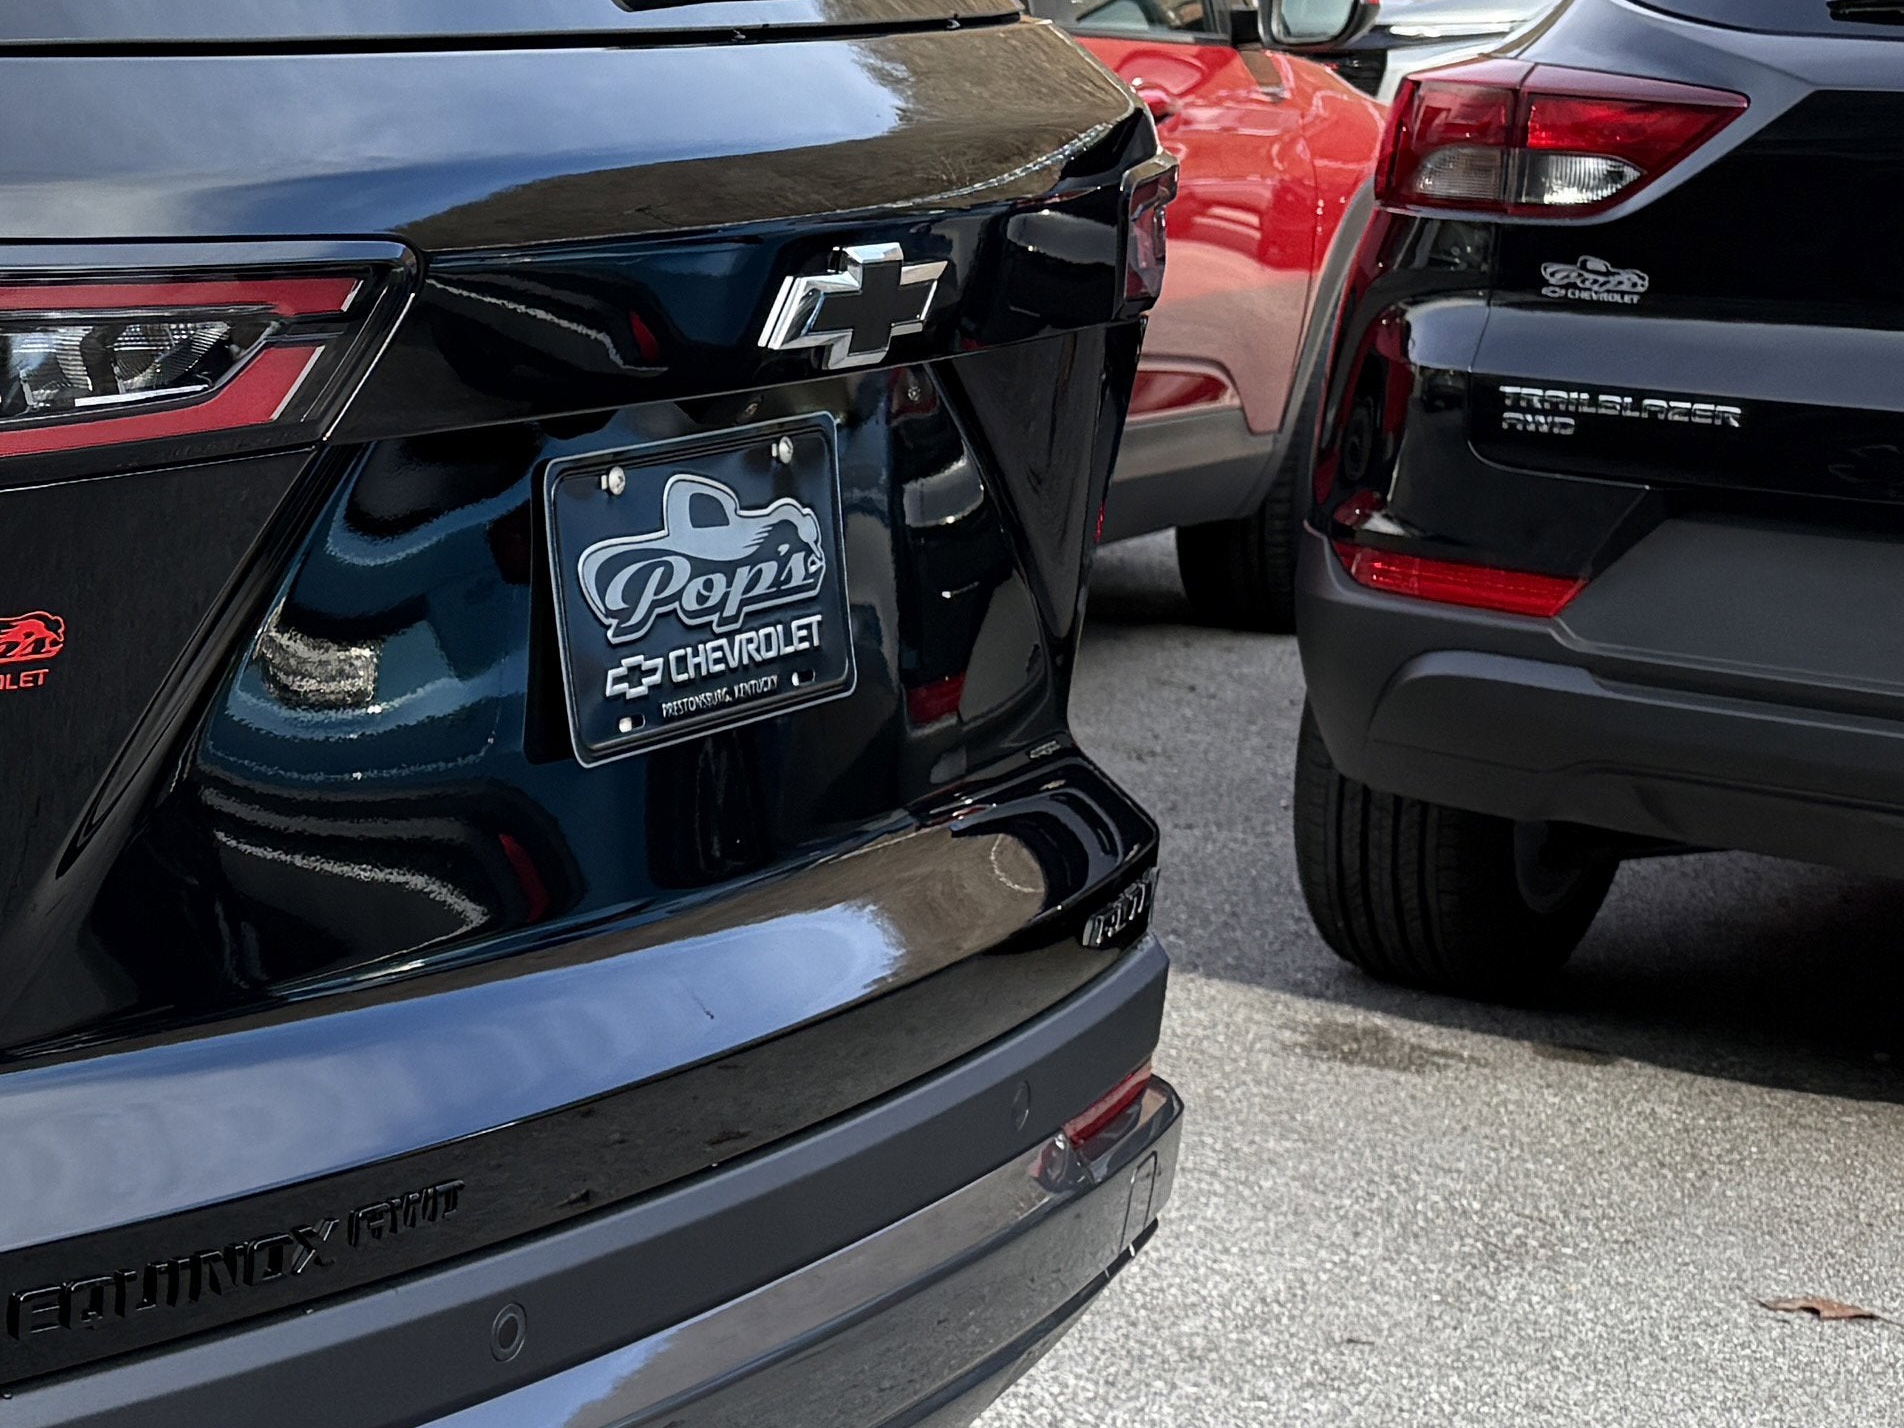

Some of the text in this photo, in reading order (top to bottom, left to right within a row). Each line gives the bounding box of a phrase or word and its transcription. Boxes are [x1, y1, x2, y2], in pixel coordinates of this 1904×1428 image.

[1567, 289, 1641, 304] CHEVROLET
[1499, 385, 1742, 428] TRAILBLAZER
[1502, 412, 1576, 435] AWD
[604, 543, 815, 628] Pop's
[669, 614, 822, 683] CHEVROLET
[733, 674, 778, 700] KENTUCKY
[6, 1217, 339, 1341] EQUINOX
